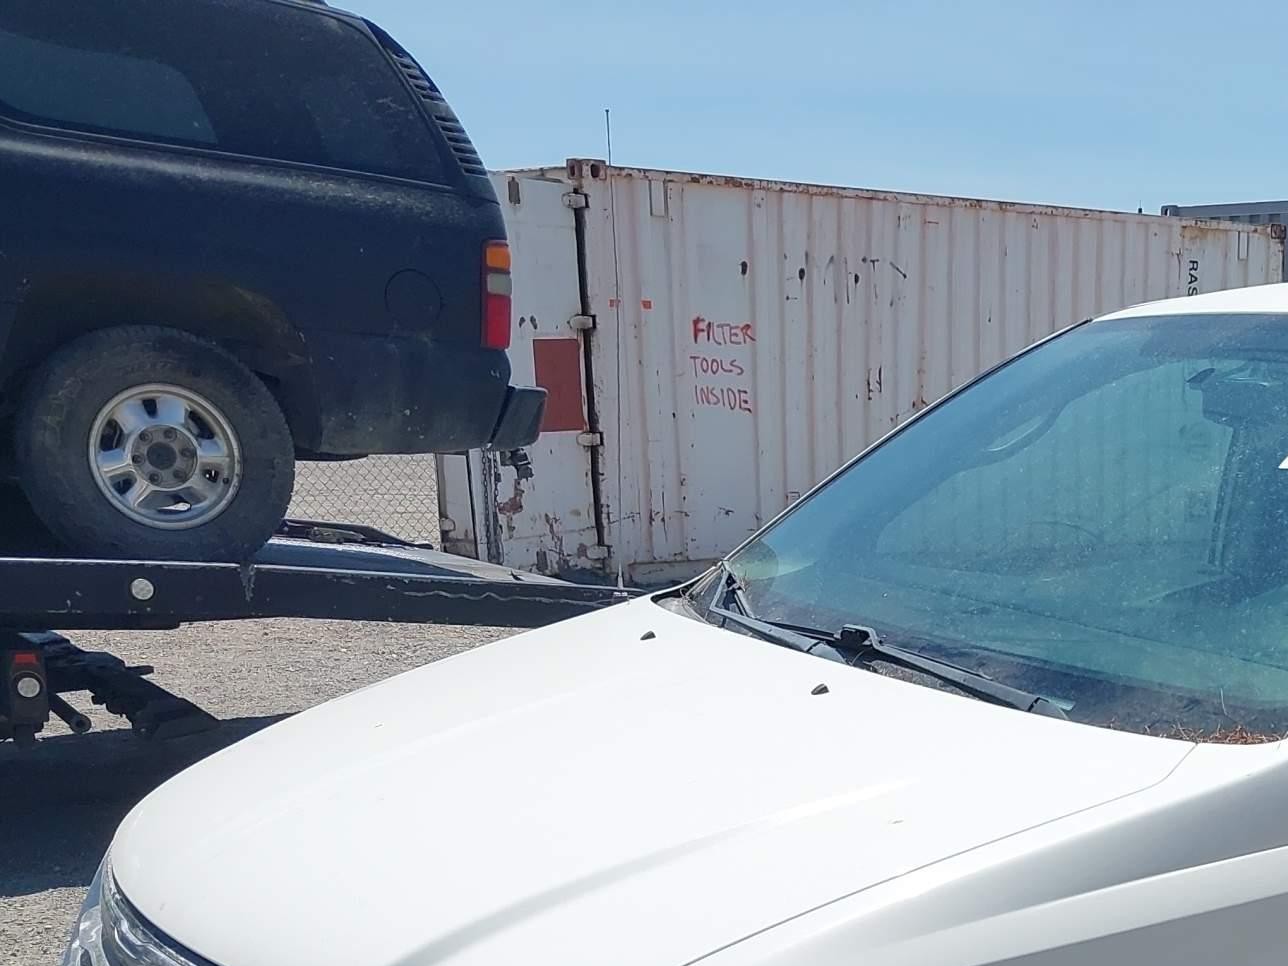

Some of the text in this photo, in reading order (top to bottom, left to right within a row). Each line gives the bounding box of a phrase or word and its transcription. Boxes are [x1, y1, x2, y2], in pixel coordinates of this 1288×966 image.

[692, 316, 756, 345] FILTER
[690, 355, 744, 376] TOOLS
[695, 385, 752, 413] INSIDE
